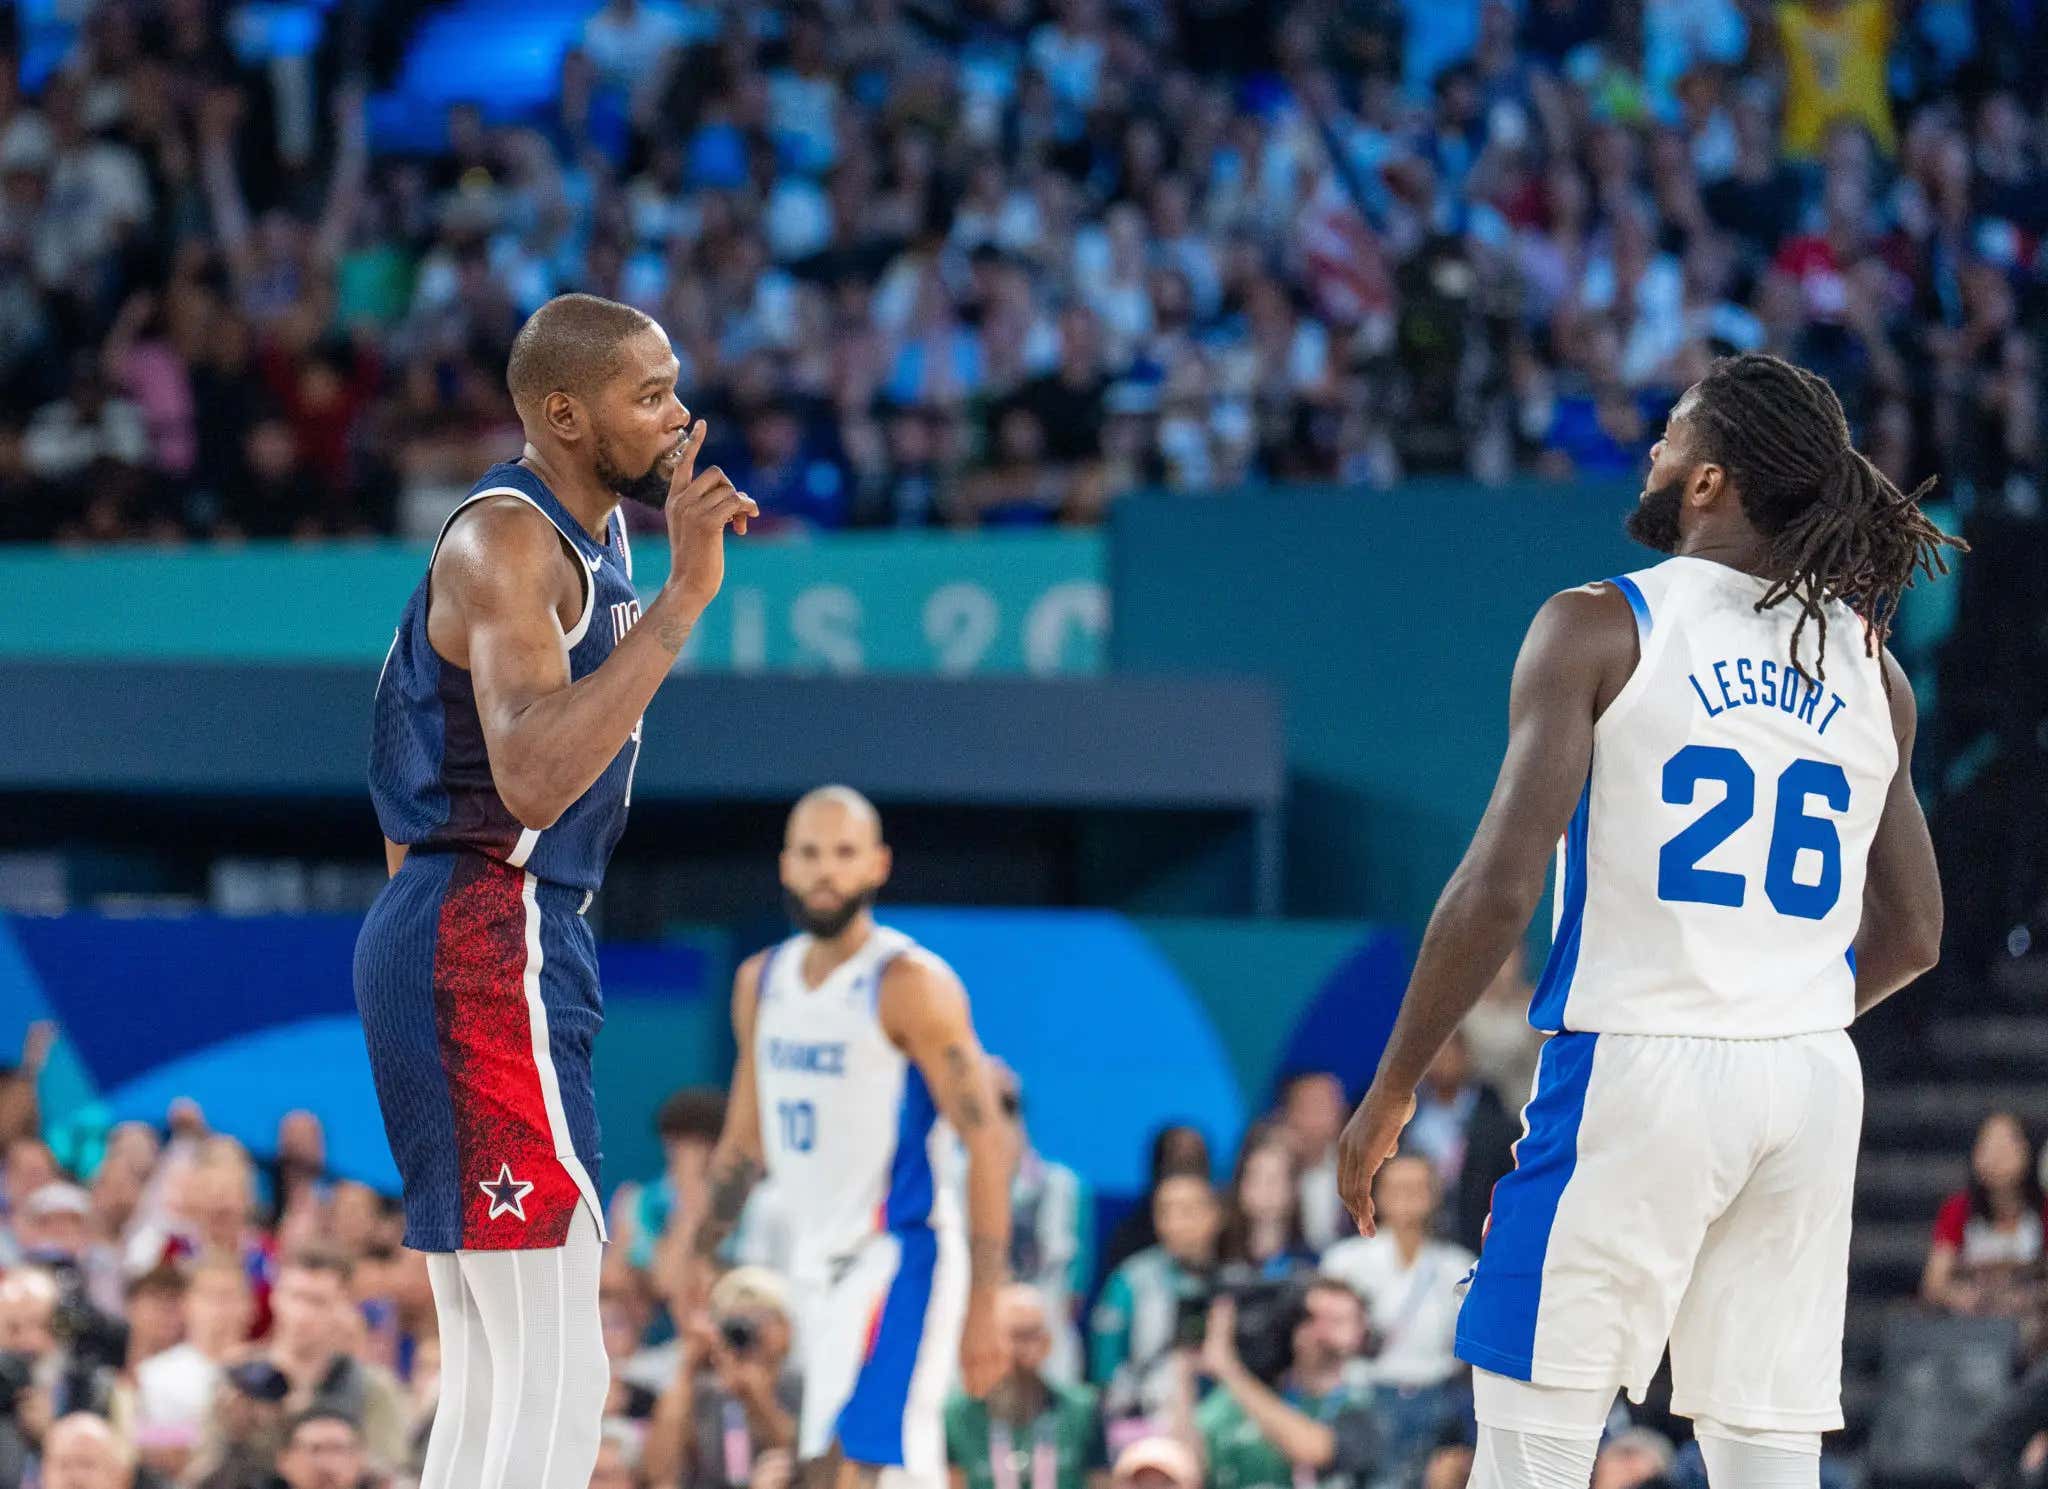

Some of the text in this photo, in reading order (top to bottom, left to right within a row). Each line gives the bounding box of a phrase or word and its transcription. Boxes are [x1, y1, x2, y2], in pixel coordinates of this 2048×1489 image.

[1688, 658, 1846, 735] LESSORT
[1657, 744, 1852, 921] 26
[776, 1098, 817, 1154] 10
